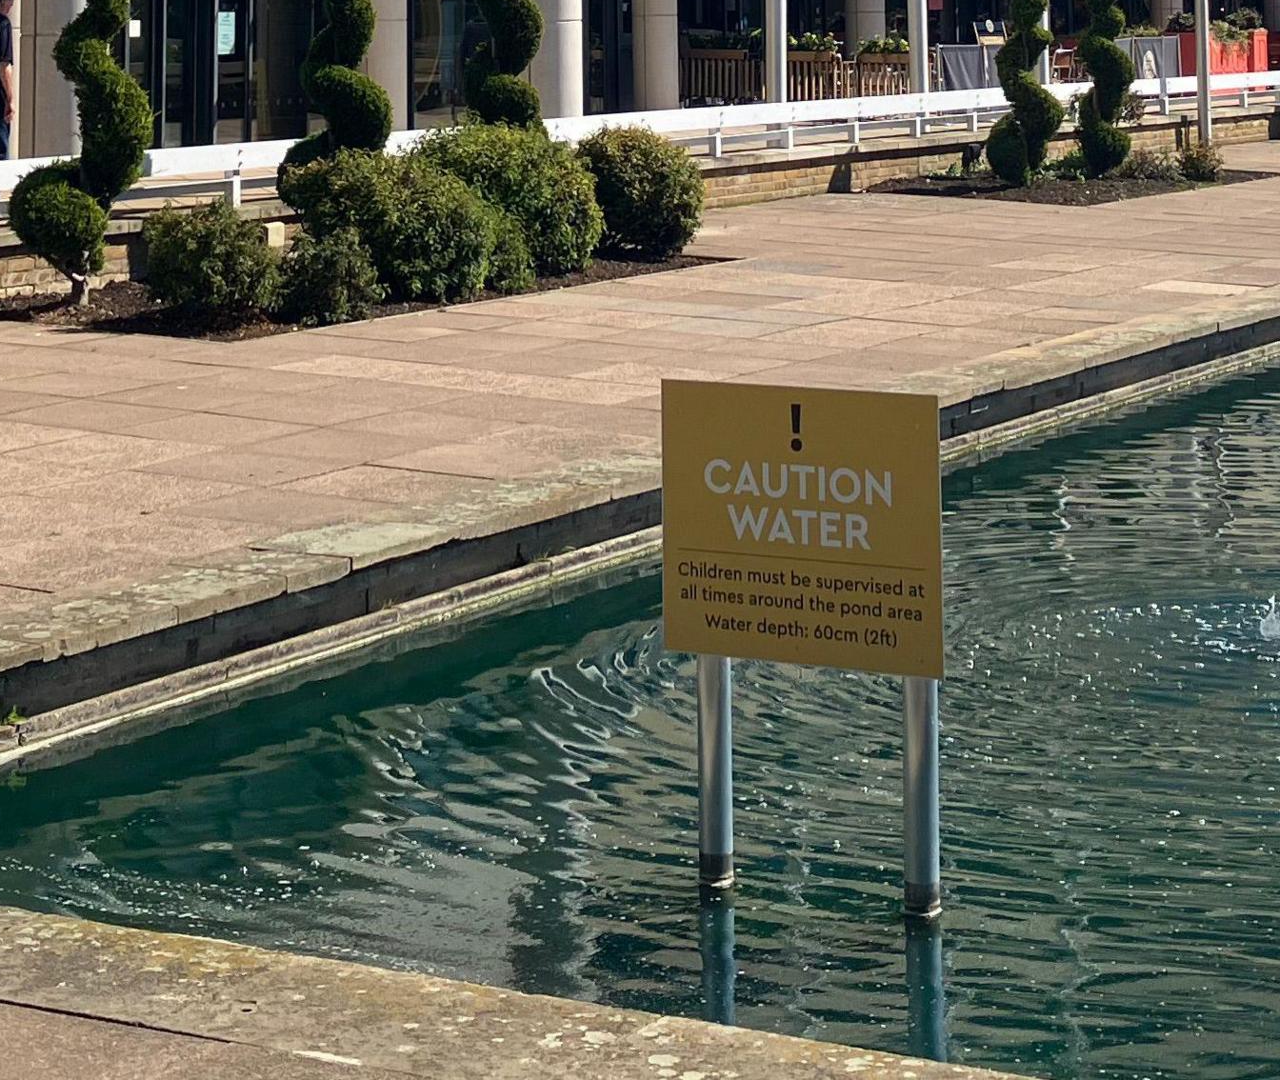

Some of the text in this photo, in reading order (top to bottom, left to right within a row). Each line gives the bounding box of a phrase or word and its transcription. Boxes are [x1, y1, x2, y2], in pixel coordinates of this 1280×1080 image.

[704, 458, 892, 508] CAUTION
[727, 504, 871, 551] WATER
[678, 561, 925, 600] Children must be supervised at
[680, 586, 923, 622] all times around the pond area
[705, 614, 898, 648] Water depth: 60cm (2ft)
